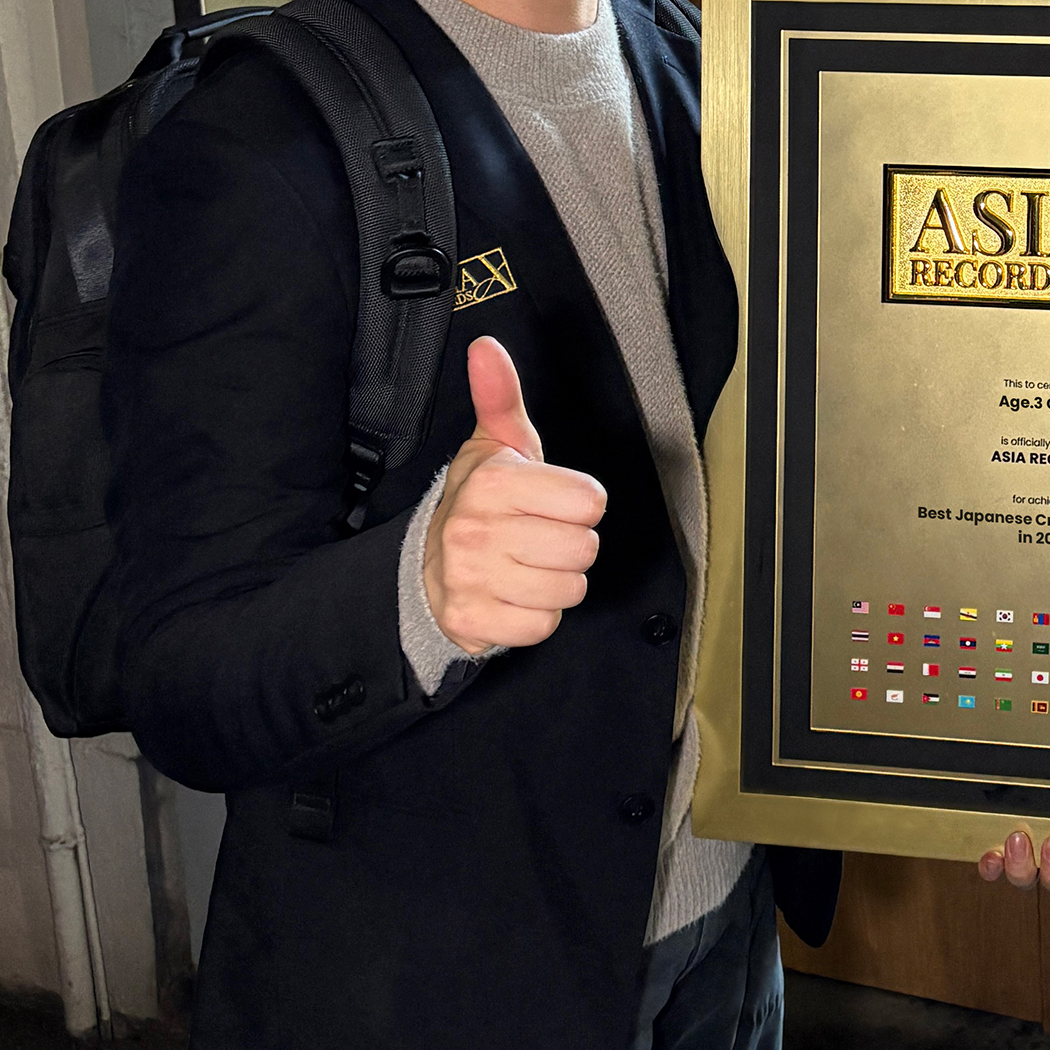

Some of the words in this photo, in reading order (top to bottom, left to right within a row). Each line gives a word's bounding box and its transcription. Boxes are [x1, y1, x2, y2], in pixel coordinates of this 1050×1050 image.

[1003, 378, 1024, 390] This
[1025, 380, 1036, 390] to
[998, 395, 1043, 412] Age.3
[1000, 436, 1010, 446] is
[991, 450, 1026, 464] ASIA
[1012, 494, 1026, 505] for
[917, 506, 953, 521] Best
[955, 508, 1033, 526] Japanese
[1018, 529, 1033, 544] in
